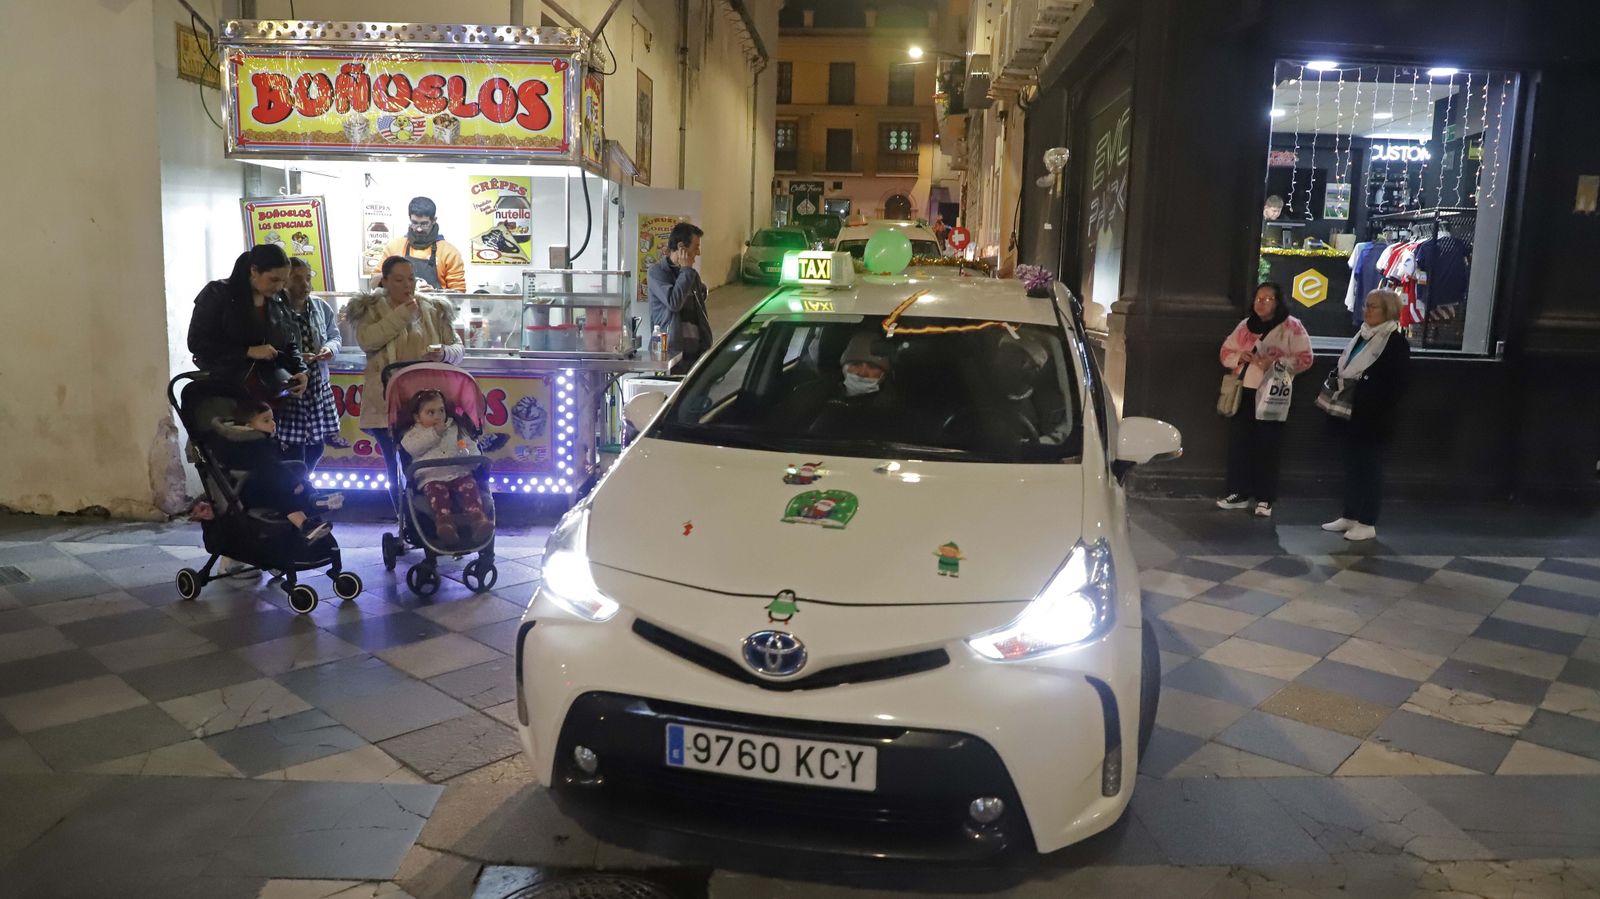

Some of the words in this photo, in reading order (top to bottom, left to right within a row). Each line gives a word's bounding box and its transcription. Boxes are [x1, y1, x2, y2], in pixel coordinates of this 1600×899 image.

[471, 177, 528, 196] CRÊPES
[495, 208, 531, 219] nutella
[273, 220, 313, 230] ESPECIALES
[798, 258, 832, 280] TAXI
[693, 733, 780, 774] 9760
[795, 745, 864, 783] KCY
